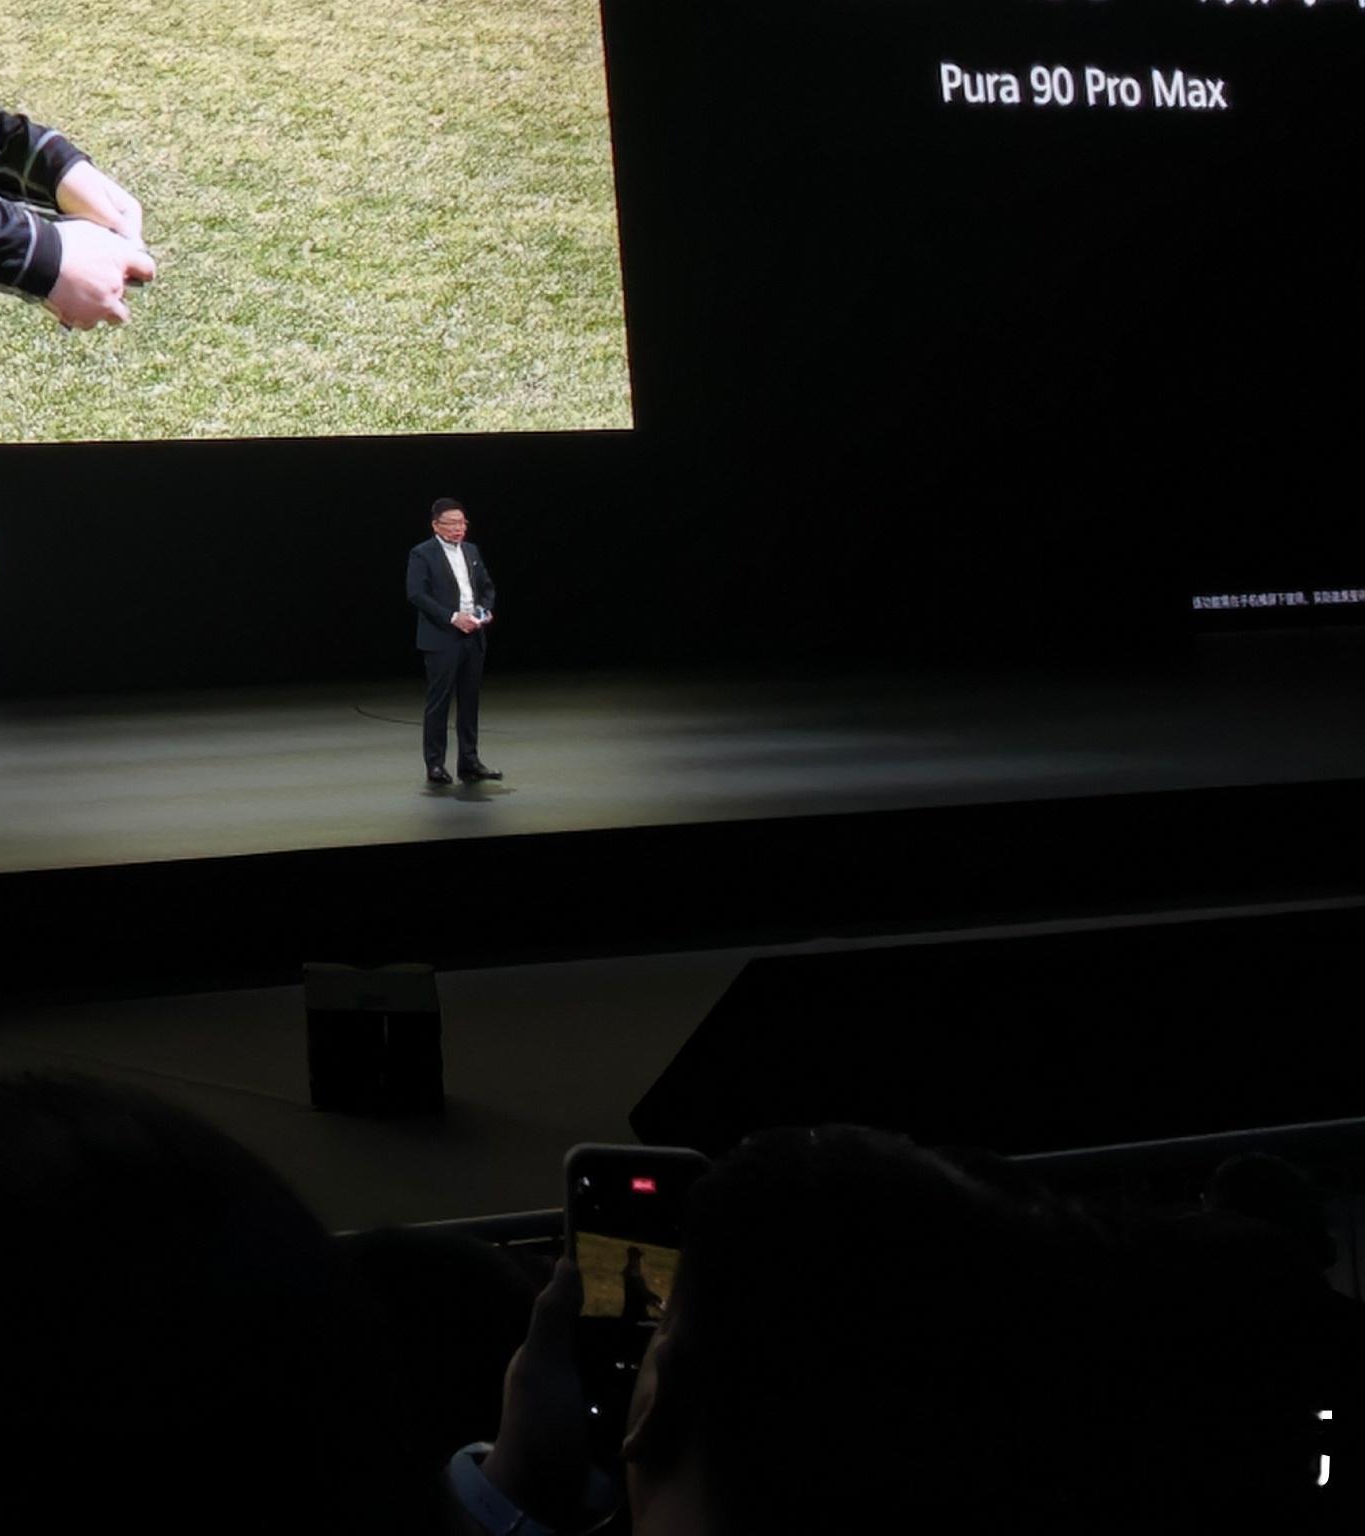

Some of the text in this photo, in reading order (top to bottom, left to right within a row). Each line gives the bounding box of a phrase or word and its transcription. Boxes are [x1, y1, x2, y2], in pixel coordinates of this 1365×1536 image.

[940, 62, 1229, 110] Pura 90 Pro Max
